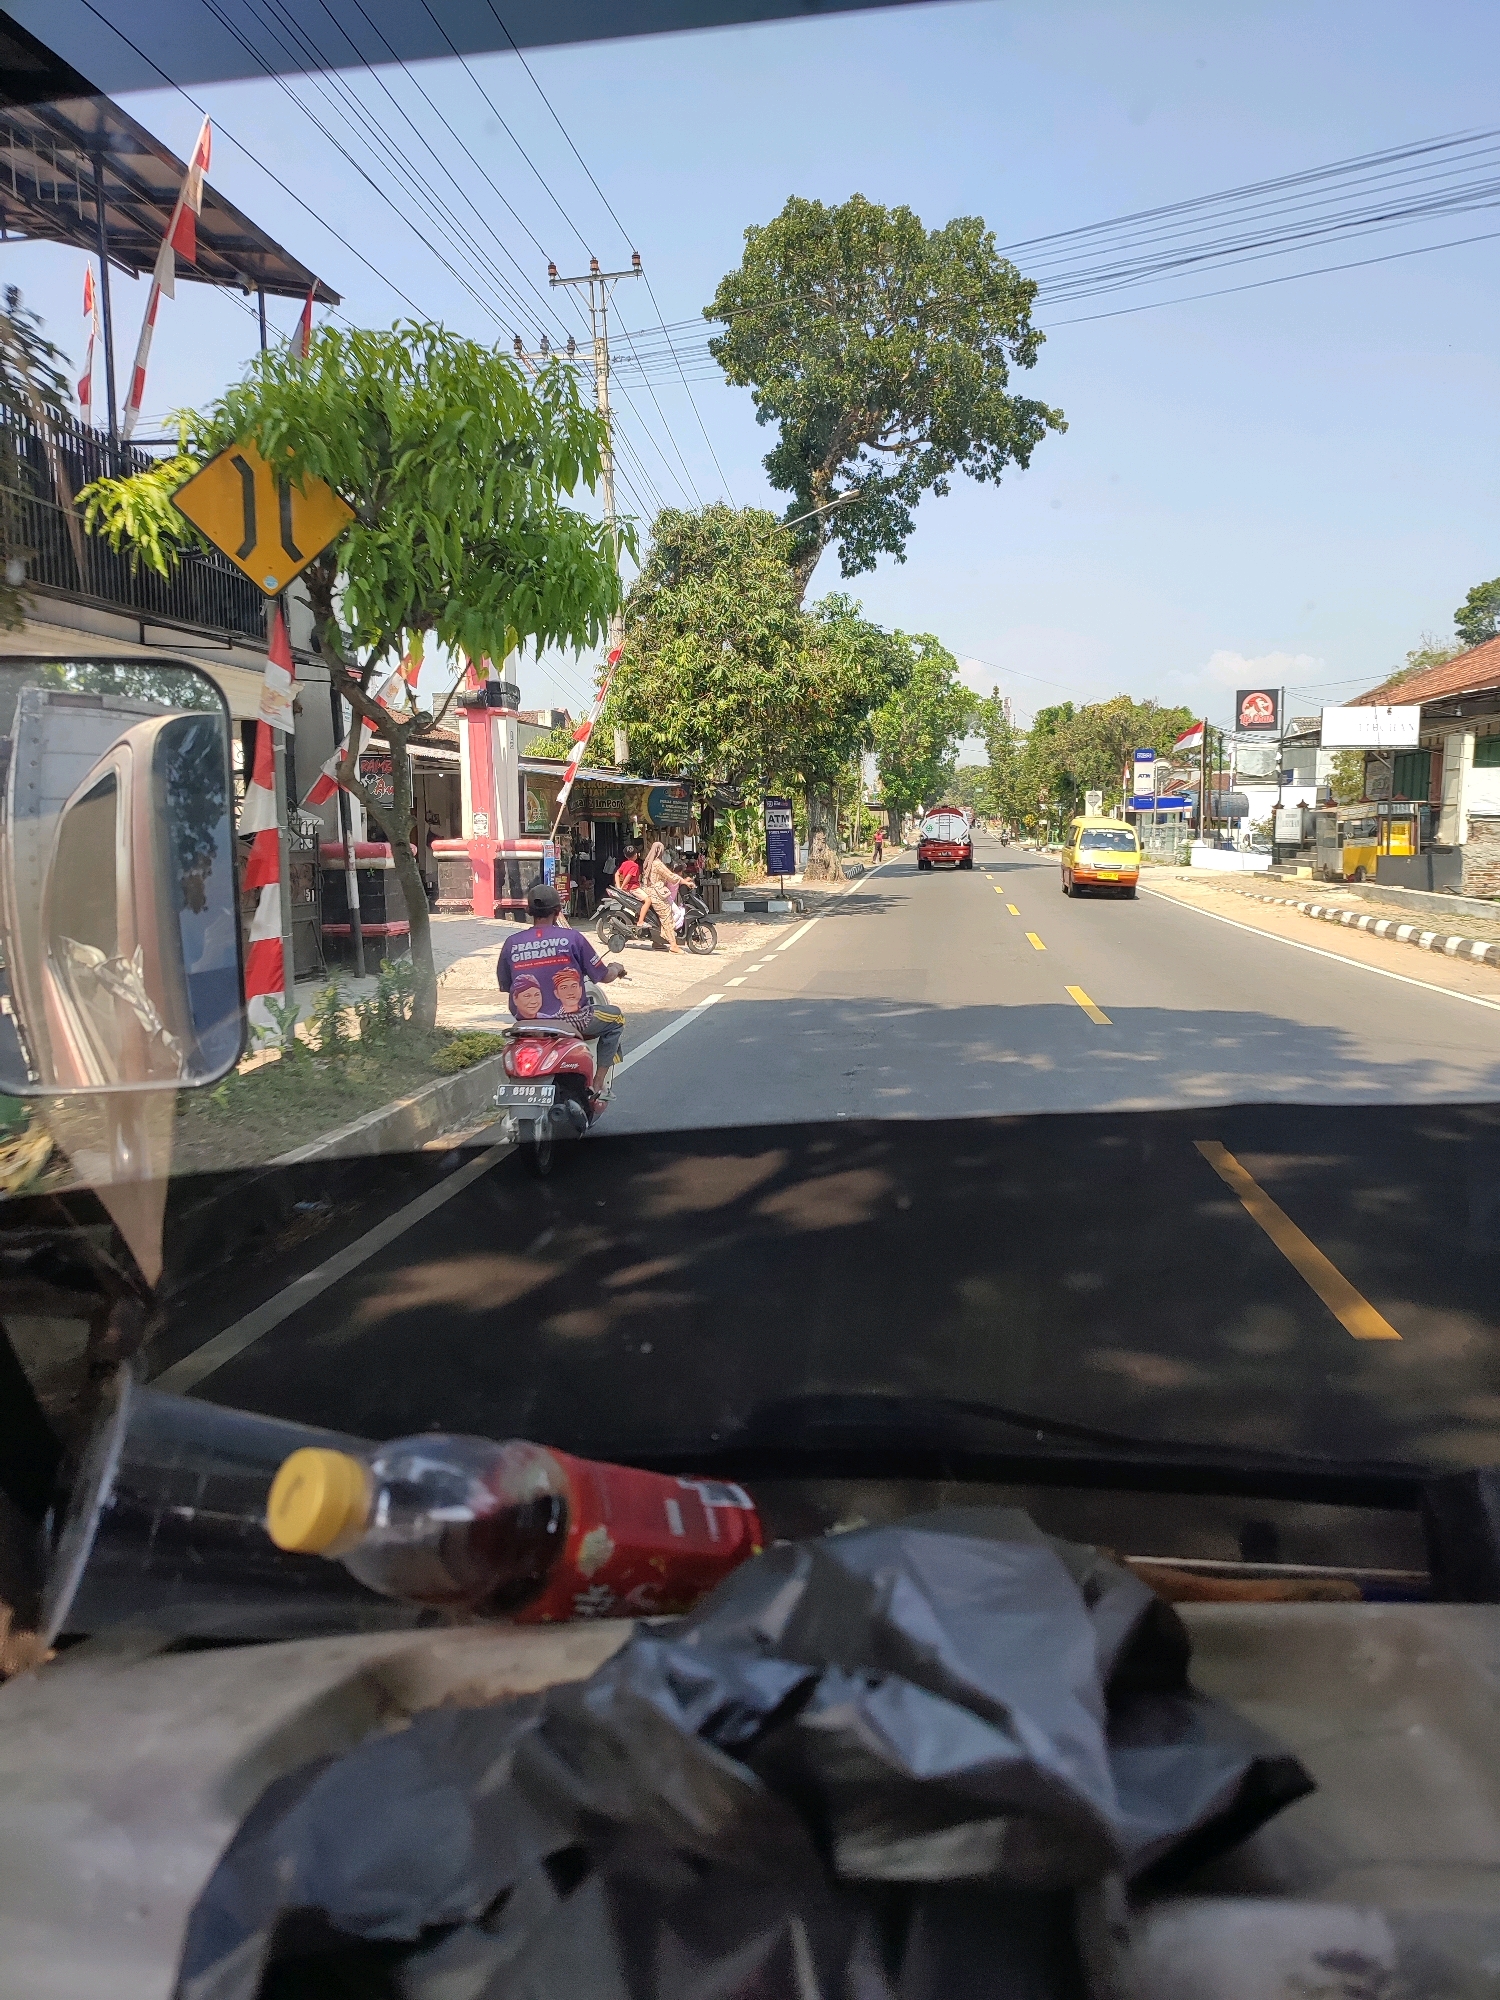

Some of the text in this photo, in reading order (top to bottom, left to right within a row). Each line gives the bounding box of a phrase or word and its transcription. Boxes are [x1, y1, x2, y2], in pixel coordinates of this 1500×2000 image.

[768, 814, 790, 824] ATM
[511, 938, 569, 953] PRABOWO
[511, 947, 556, 962] GIBRAN
